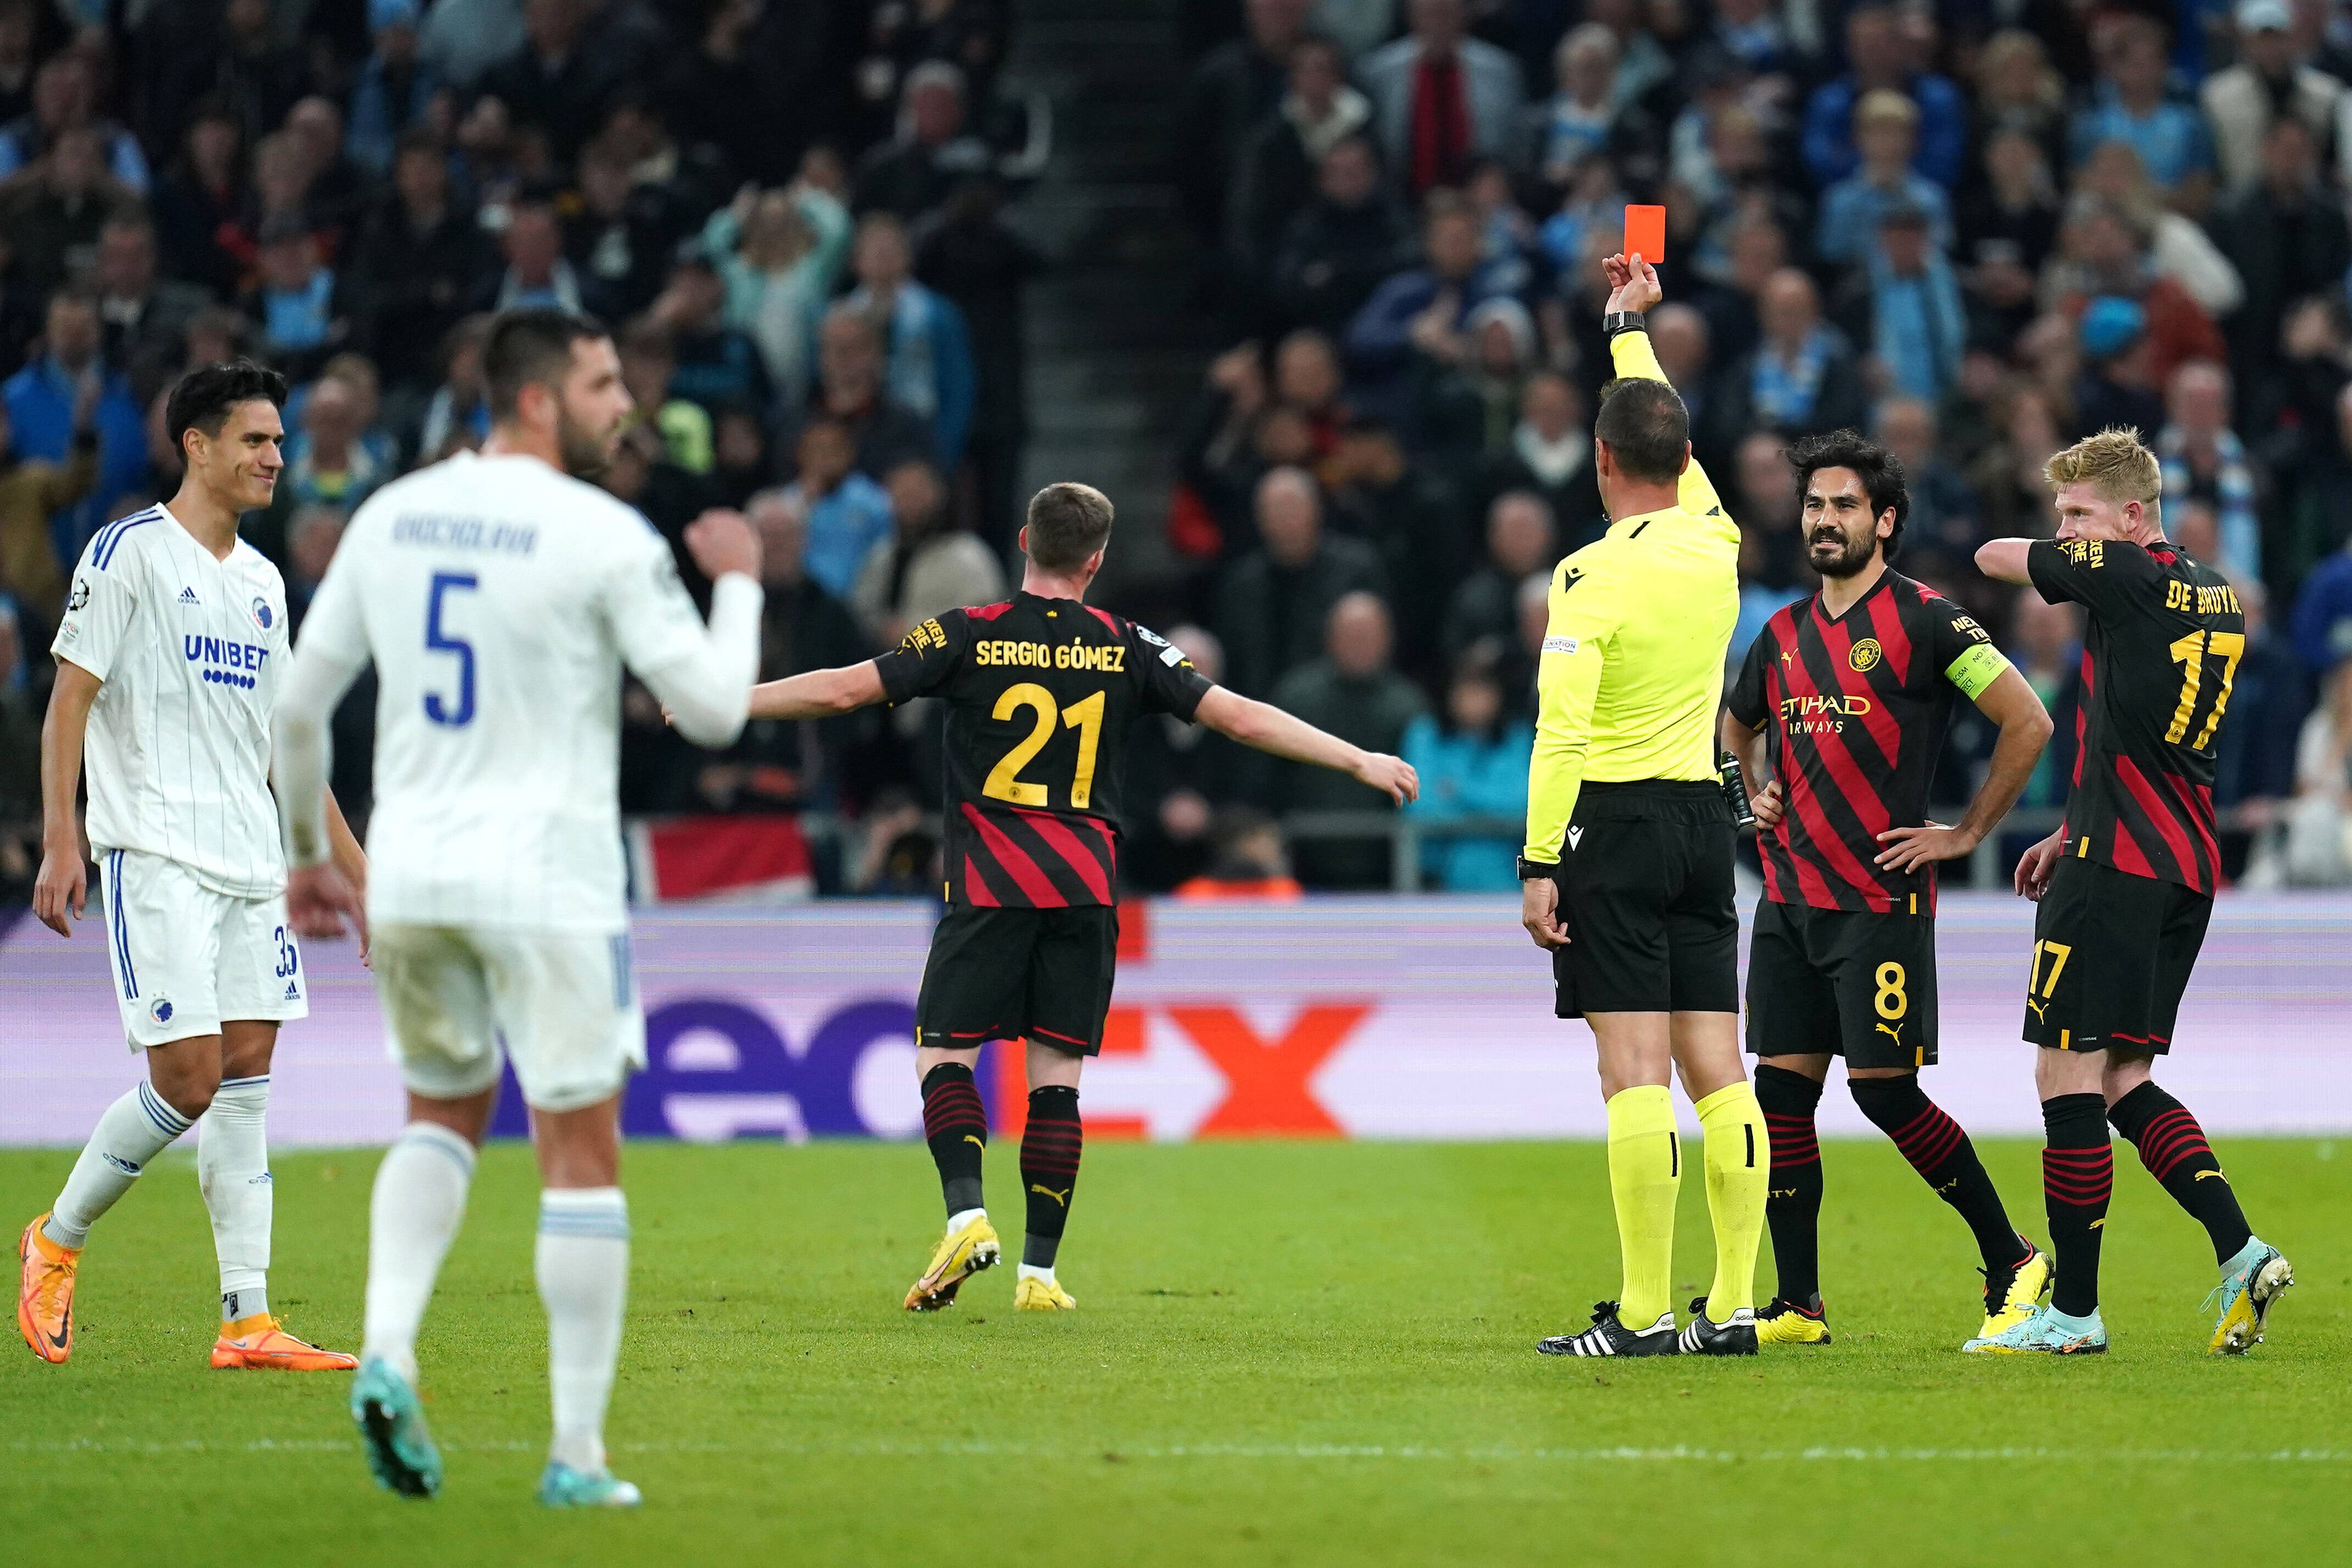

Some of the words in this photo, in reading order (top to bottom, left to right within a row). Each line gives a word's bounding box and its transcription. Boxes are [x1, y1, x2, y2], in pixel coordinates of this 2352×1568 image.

[2074, 540, 2087, 563] IRE
[2089, 540, 2104, 569] XEN
[2166, 580, 2192, 611] DE
[2196, 585, 2242, 615] BRUYN
[185, 635, 269, 673] UNIBET
[423, 570, 480, 728] 5
[976, 640, 1051, 668] SERGIO
[1055, 636, 1125, 672] GÓMEZ
[1973, 651, 1983, 663] NO
[2164, 629, 2245, 750] 17
[1780, 695, 1871, 721] ETIHAD
[982, 682, 1106, 808] 21
[1789, 721, 1843, 735] IRWAYS
[2029, 938, 2072, 999] 17
[1875, 961, 1907, 1019] 8
